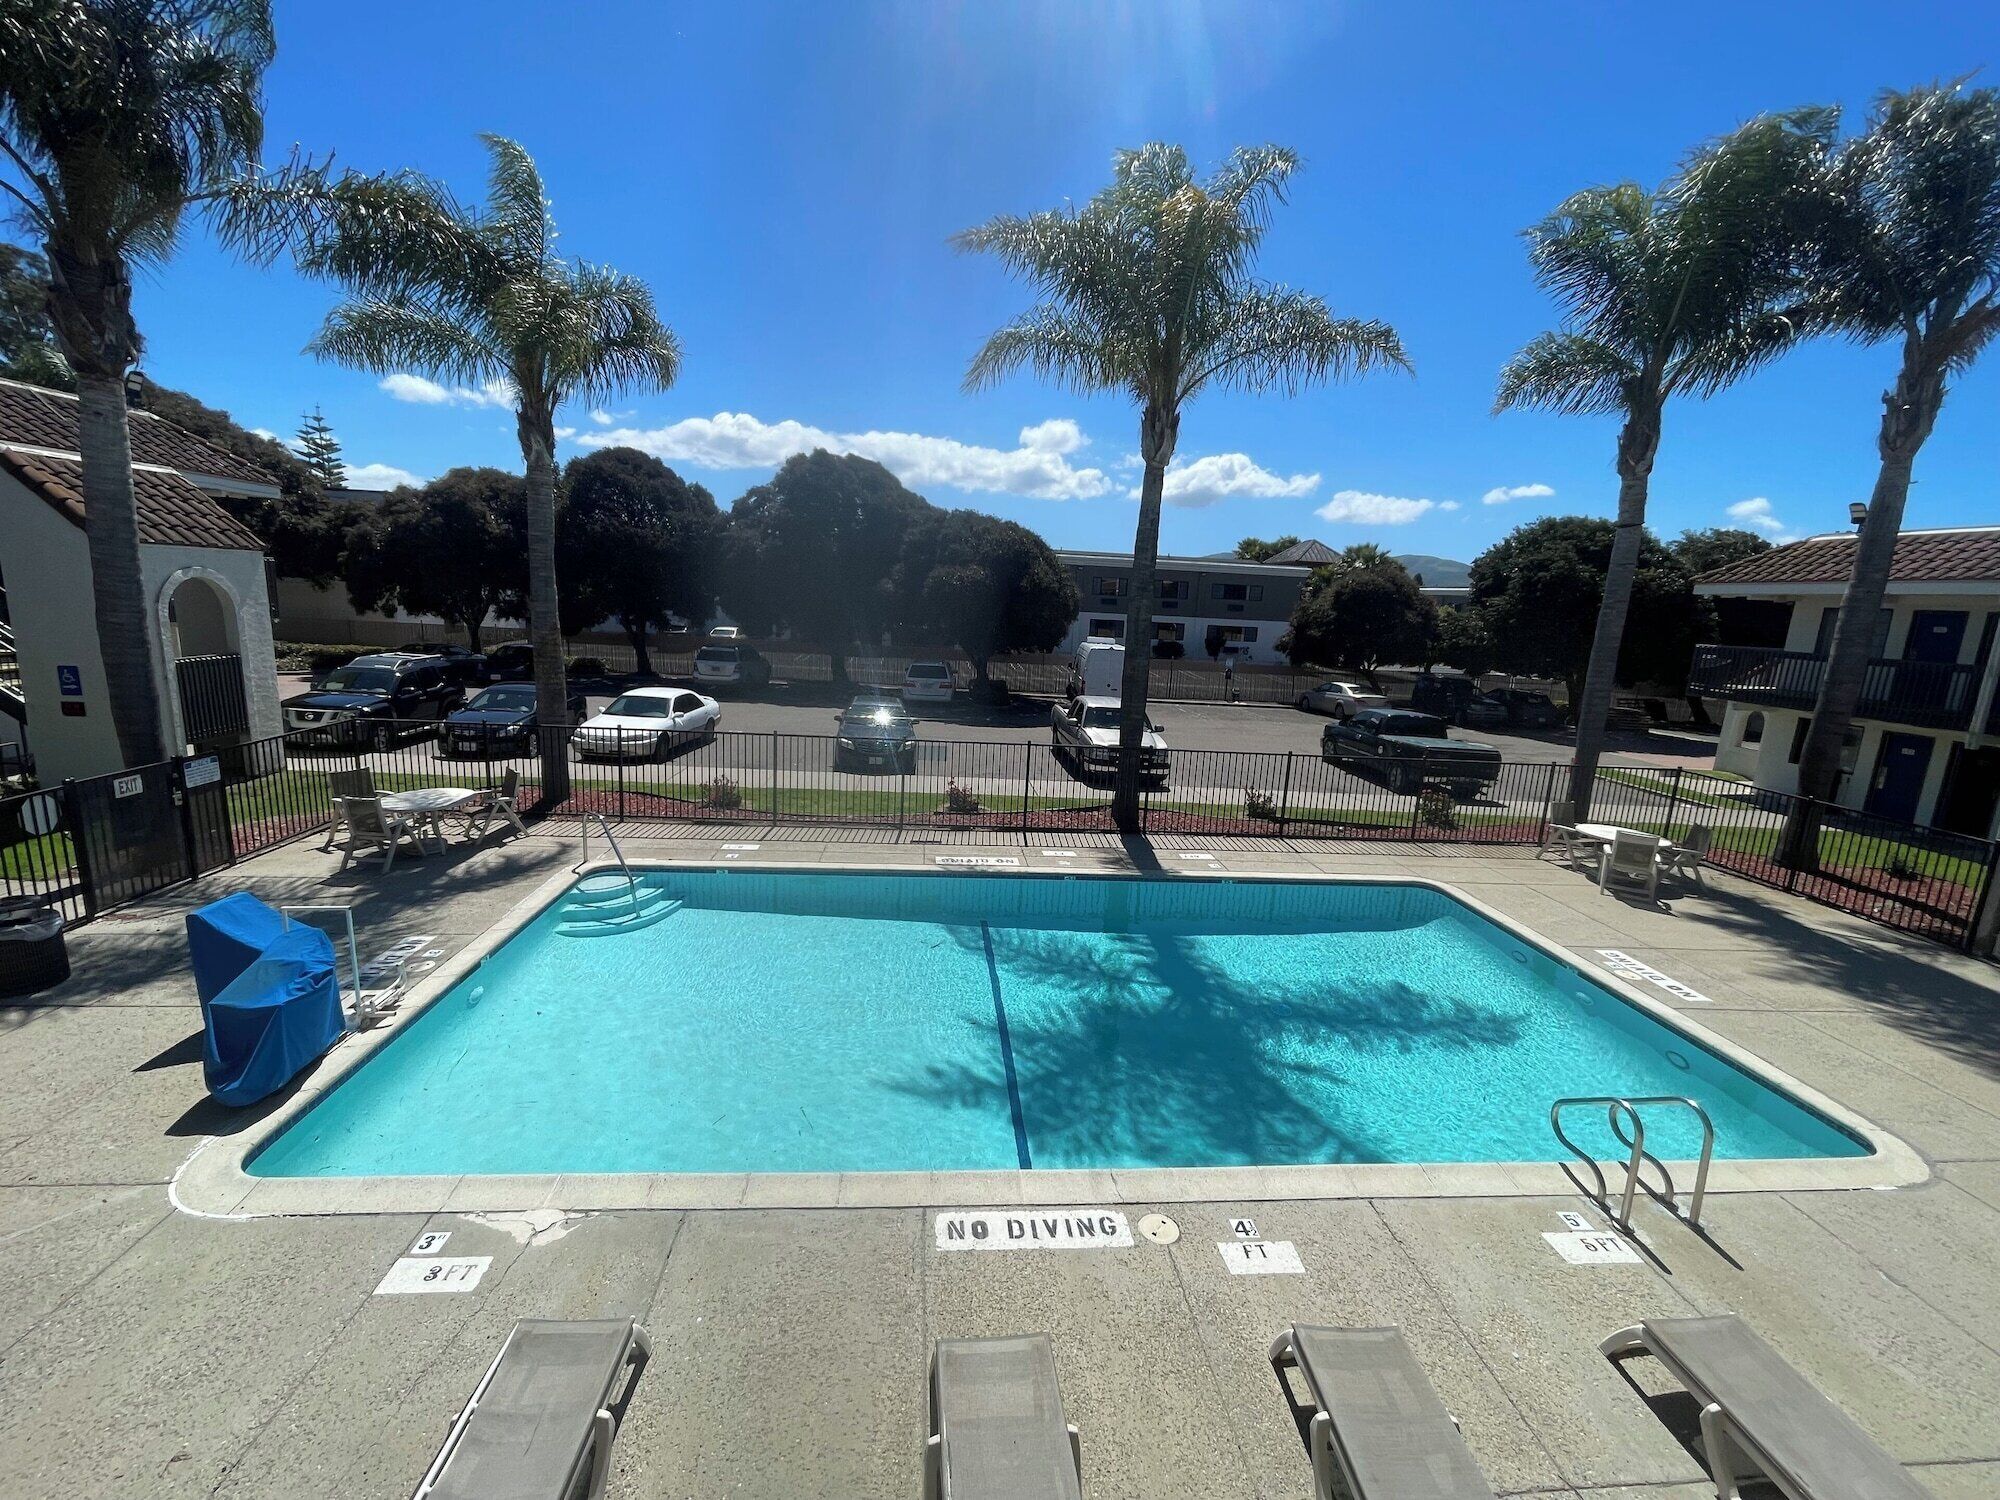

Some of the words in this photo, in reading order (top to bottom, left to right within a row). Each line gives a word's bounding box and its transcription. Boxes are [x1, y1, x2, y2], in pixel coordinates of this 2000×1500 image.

[118, 777, 138, 796] EXIT
[1604, 951, 1667, 982] DIVING
[1667, 984, 1699, 999] NO
[946, 1219, 989, 1241] NO
[1006, 1216, 1118, 1240] DIVING
[1242, 1244, 1268, 1259] FT
